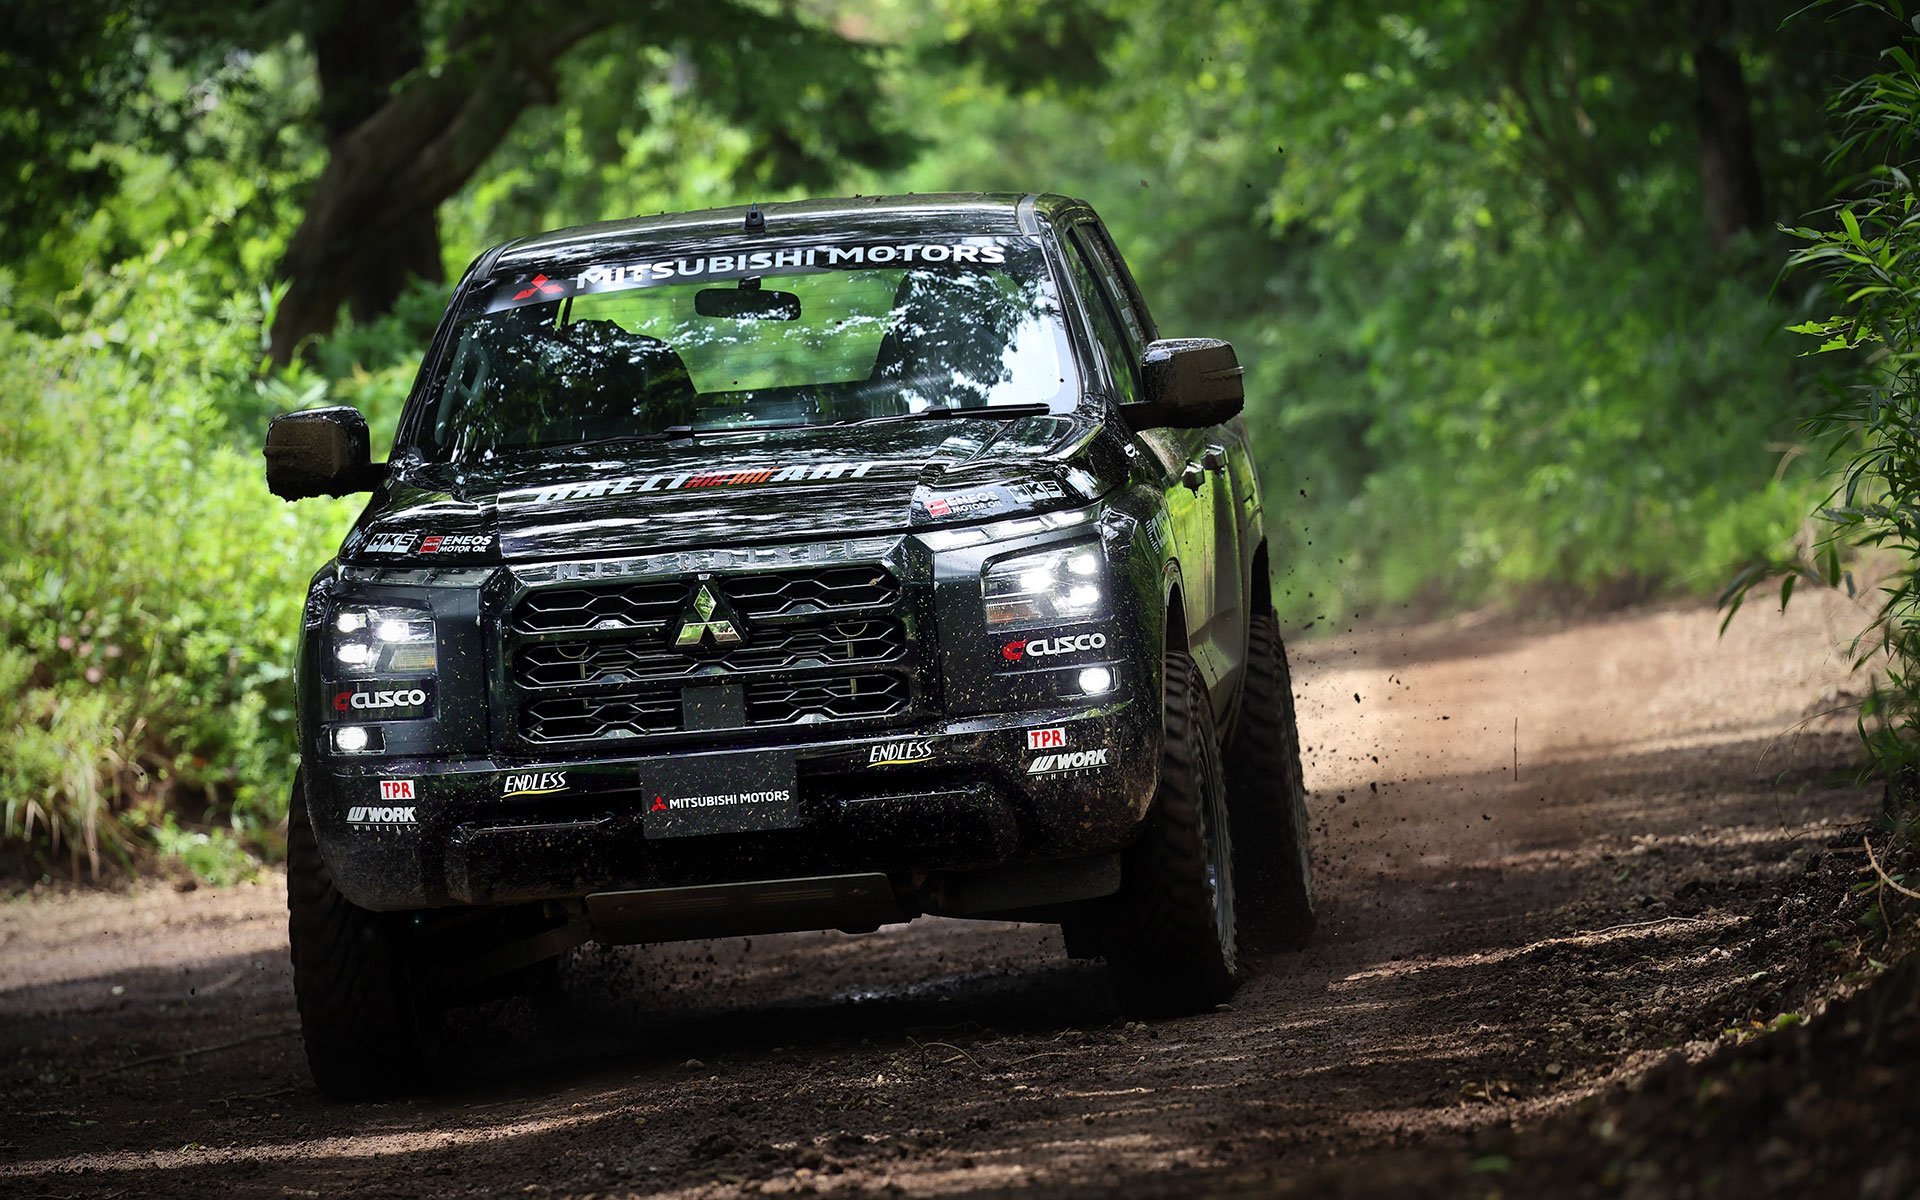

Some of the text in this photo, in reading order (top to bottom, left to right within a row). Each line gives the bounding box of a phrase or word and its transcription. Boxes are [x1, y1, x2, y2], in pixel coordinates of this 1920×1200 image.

[576, 244, 1006, 290] MITSUBISHI MOTORS
[947, 491, 999, 506] ENEOS
[1007, 481, 1065, 502] HKS
[951, 503, 987, 514] MOTOR
[989, 500, 1004, 508] OIL
[366, 533, 418, 550] HKS
[439, 545, 487, 553] MOTOR OIL
[441, 535, 493, 545] ENEOS
[556, 541, 852, 580] MITSUBISHI
[1025, 632, 1107, 657] CUSCO
[350, 689, 427, 709] CUSCO
[1030, 729, 1063, 748] TPR
[869, 740, 933, 763] ENDLESS
[1057, 748, 1109, 769] WORK
[503, 771, 567, 792] ENDLESS
[1035, 767, 1101, 781] WHEELS
[382, 782, 412, 798] TPR
[669, 789, 790, 810] MITSUBISHI MOTORS
[367, 806, 417, 822] WORK
[353, 824, 411, 832] WHEELS
